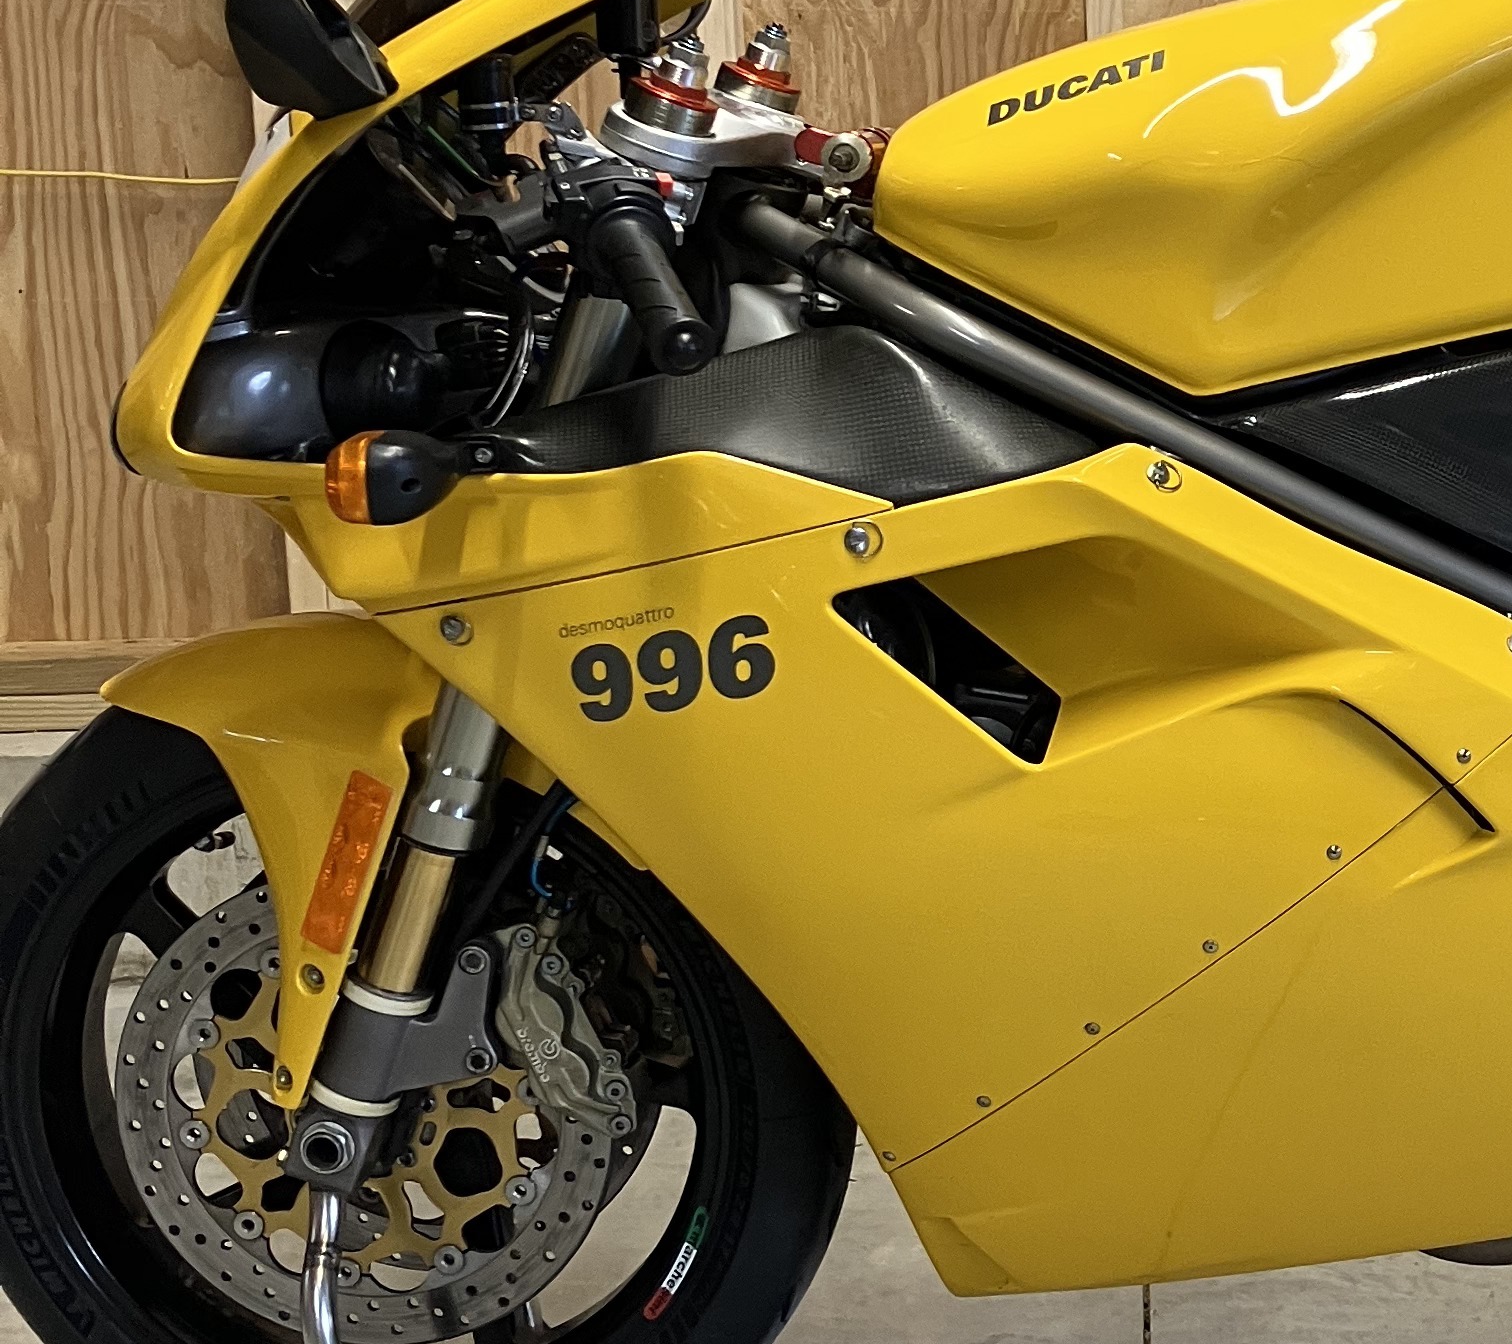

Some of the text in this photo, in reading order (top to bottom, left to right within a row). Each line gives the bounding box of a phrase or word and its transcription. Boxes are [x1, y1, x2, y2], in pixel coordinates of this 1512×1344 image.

[987, 49, 1166, 127] DUCATI
[558, 606, 675, 639] desmoquattro
[571, 614, 776, 722] 996
[516, 1026, 551, 1083] brembo
